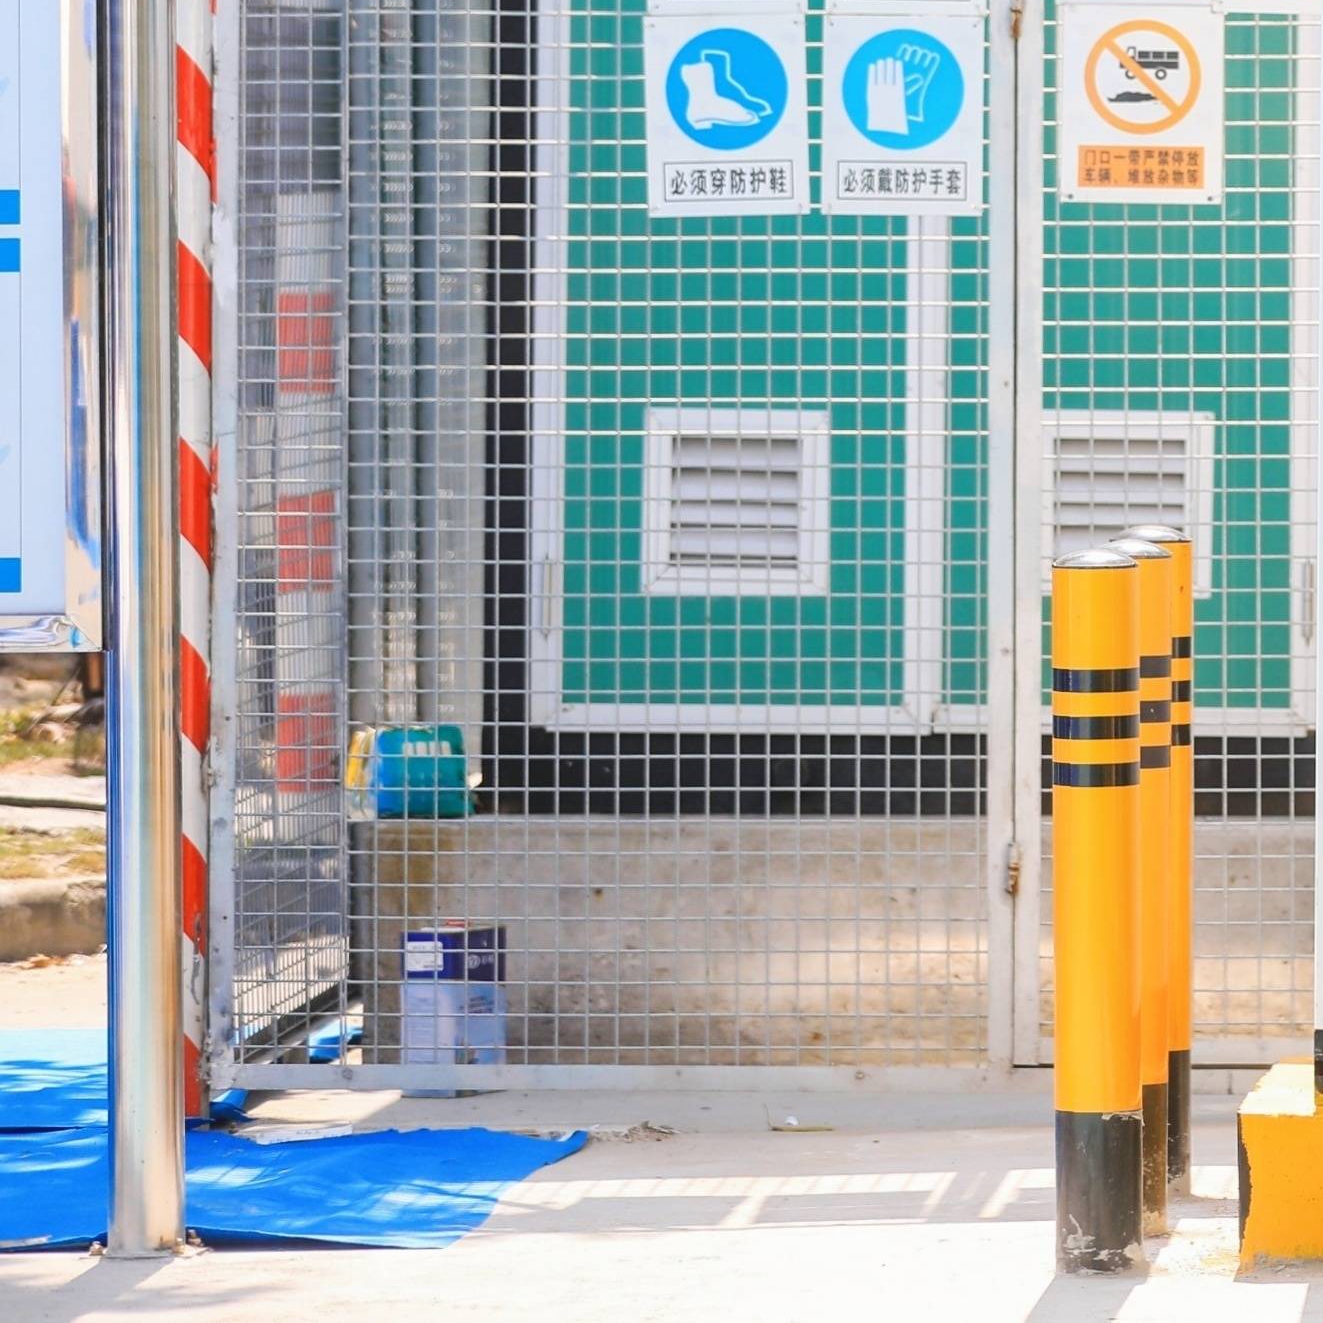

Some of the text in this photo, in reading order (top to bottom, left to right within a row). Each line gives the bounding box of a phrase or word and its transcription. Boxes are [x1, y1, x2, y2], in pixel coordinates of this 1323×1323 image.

[671, 167, 787, 196] 必须穿防护鞋
[843, 168, 962, 195] 必须戴防护手套
